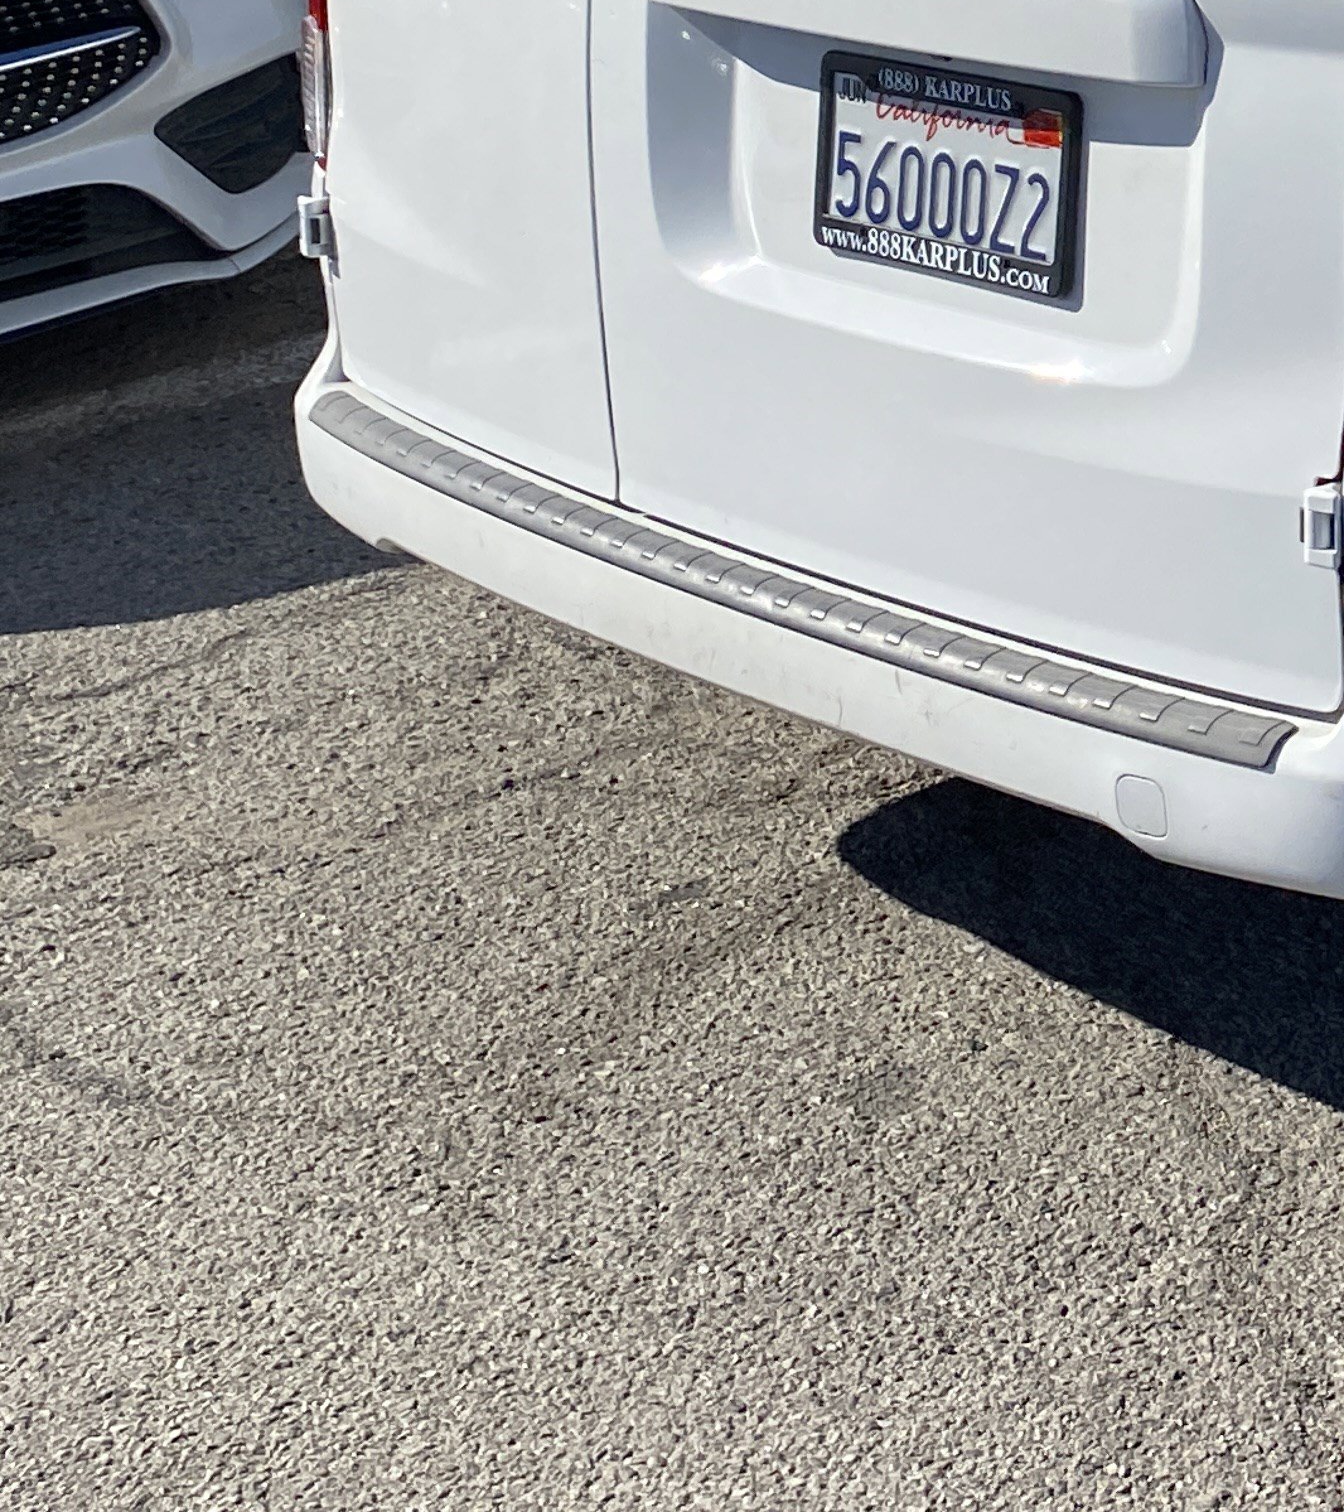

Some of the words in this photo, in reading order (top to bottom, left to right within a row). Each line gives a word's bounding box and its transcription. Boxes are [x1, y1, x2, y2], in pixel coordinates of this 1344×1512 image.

[878, 67, 920, 94] (888)
[924, 75, 1012, 111] KARPLUS
[876, 91, 1026, 145] California
[835, 130, 1050, 261] 56000Z2
